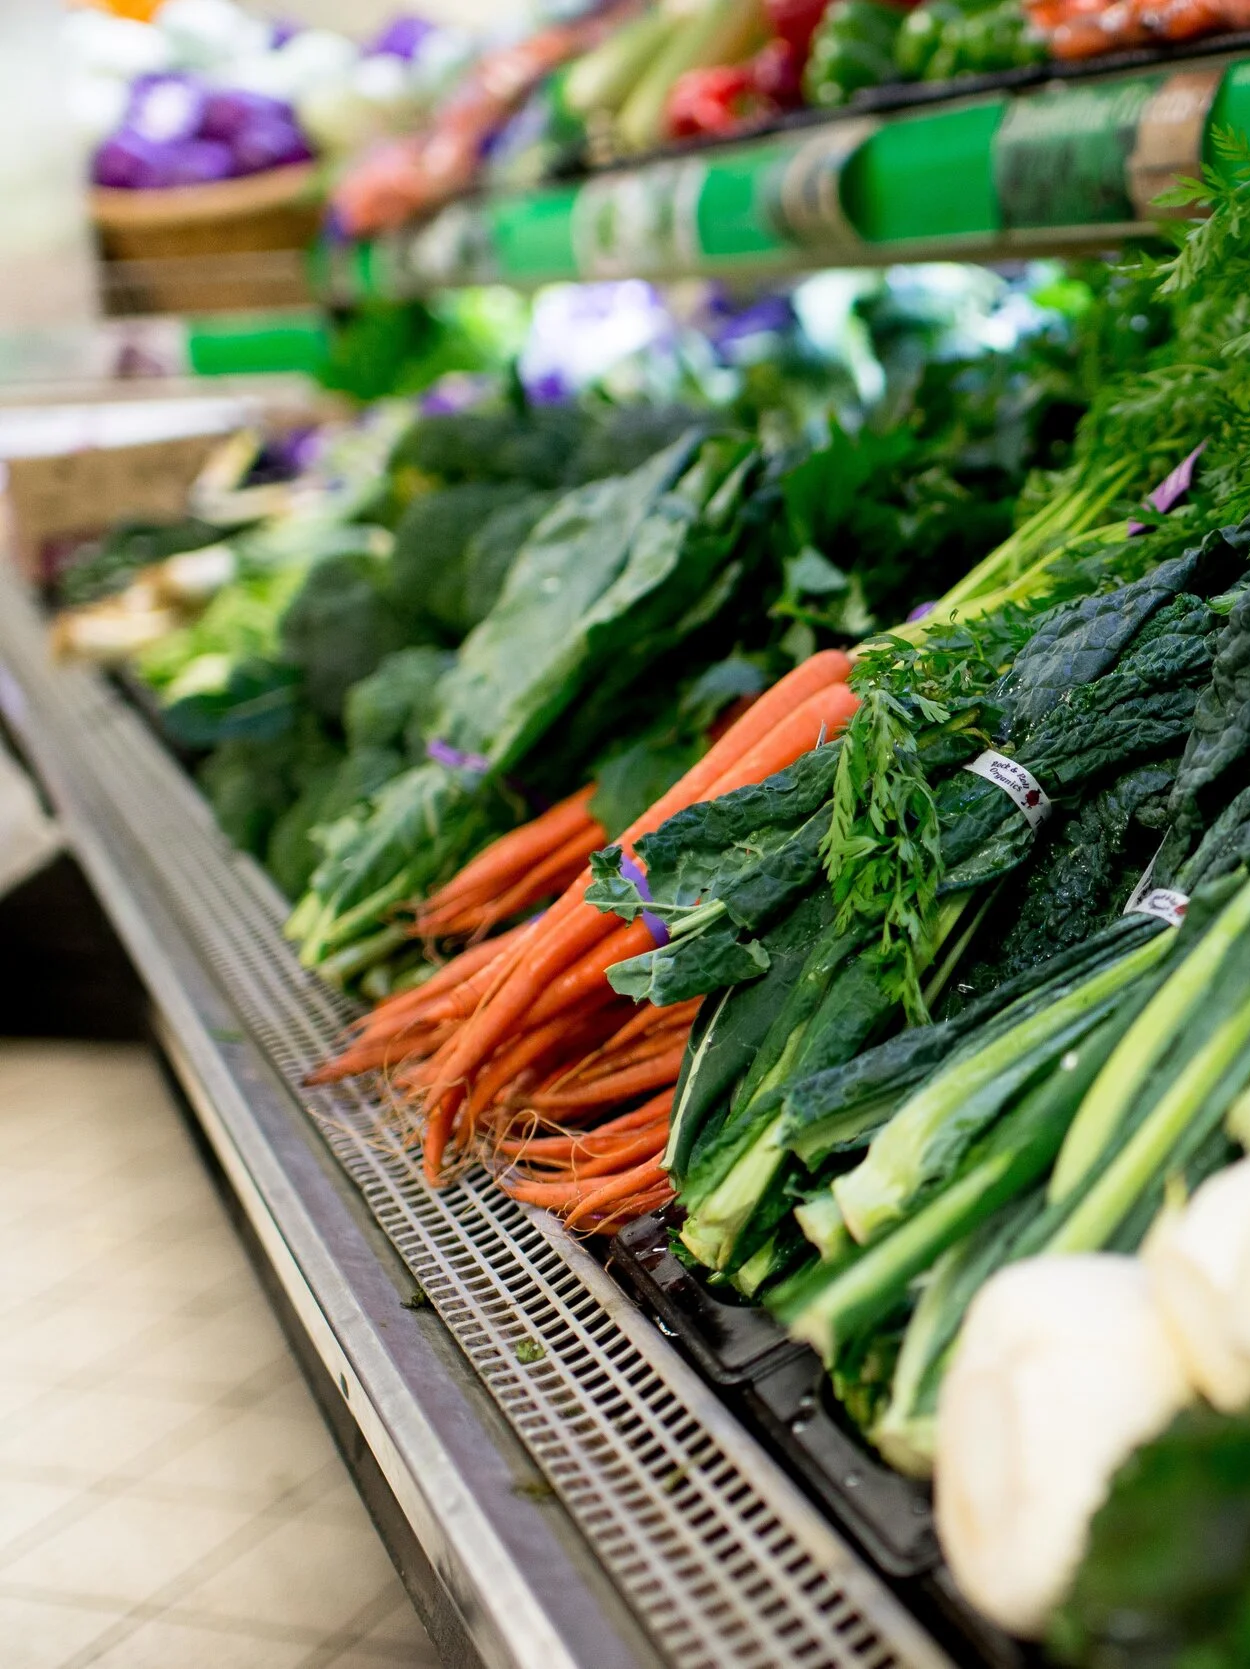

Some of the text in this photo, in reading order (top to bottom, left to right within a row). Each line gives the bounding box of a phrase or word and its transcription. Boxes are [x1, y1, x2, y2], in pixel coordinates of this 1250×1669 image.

[990, 767, 1023, 792] Organics
[991, 760, 1011, 770] Rock
[1017, 773, 1030, 789] Roll
